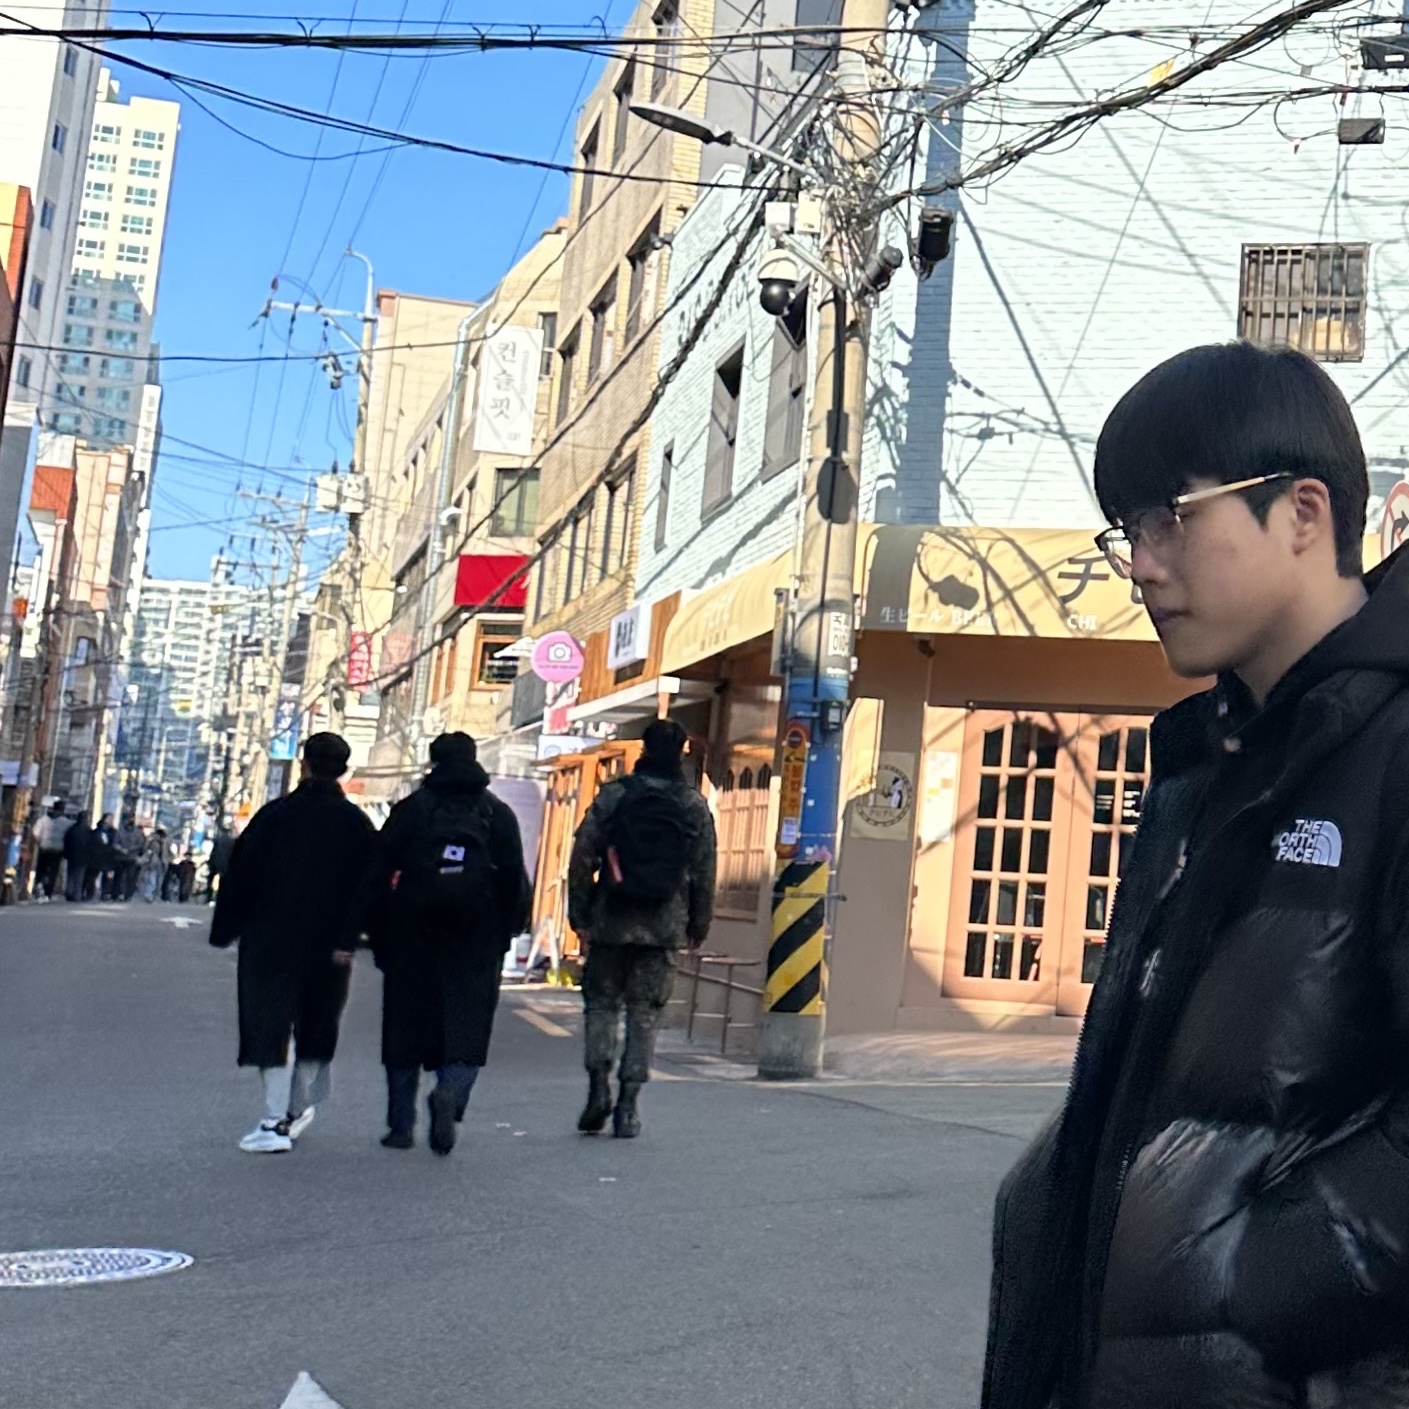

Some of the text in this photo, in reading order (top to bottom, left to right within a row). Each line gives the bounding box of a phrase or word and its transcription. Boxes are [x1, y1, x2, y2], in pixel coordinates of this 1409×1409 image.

[1067, 614, 1097, 631] CHI
[1295, 820, 1323, 834] THE
[1275, 847, 1314, 863] FACE
